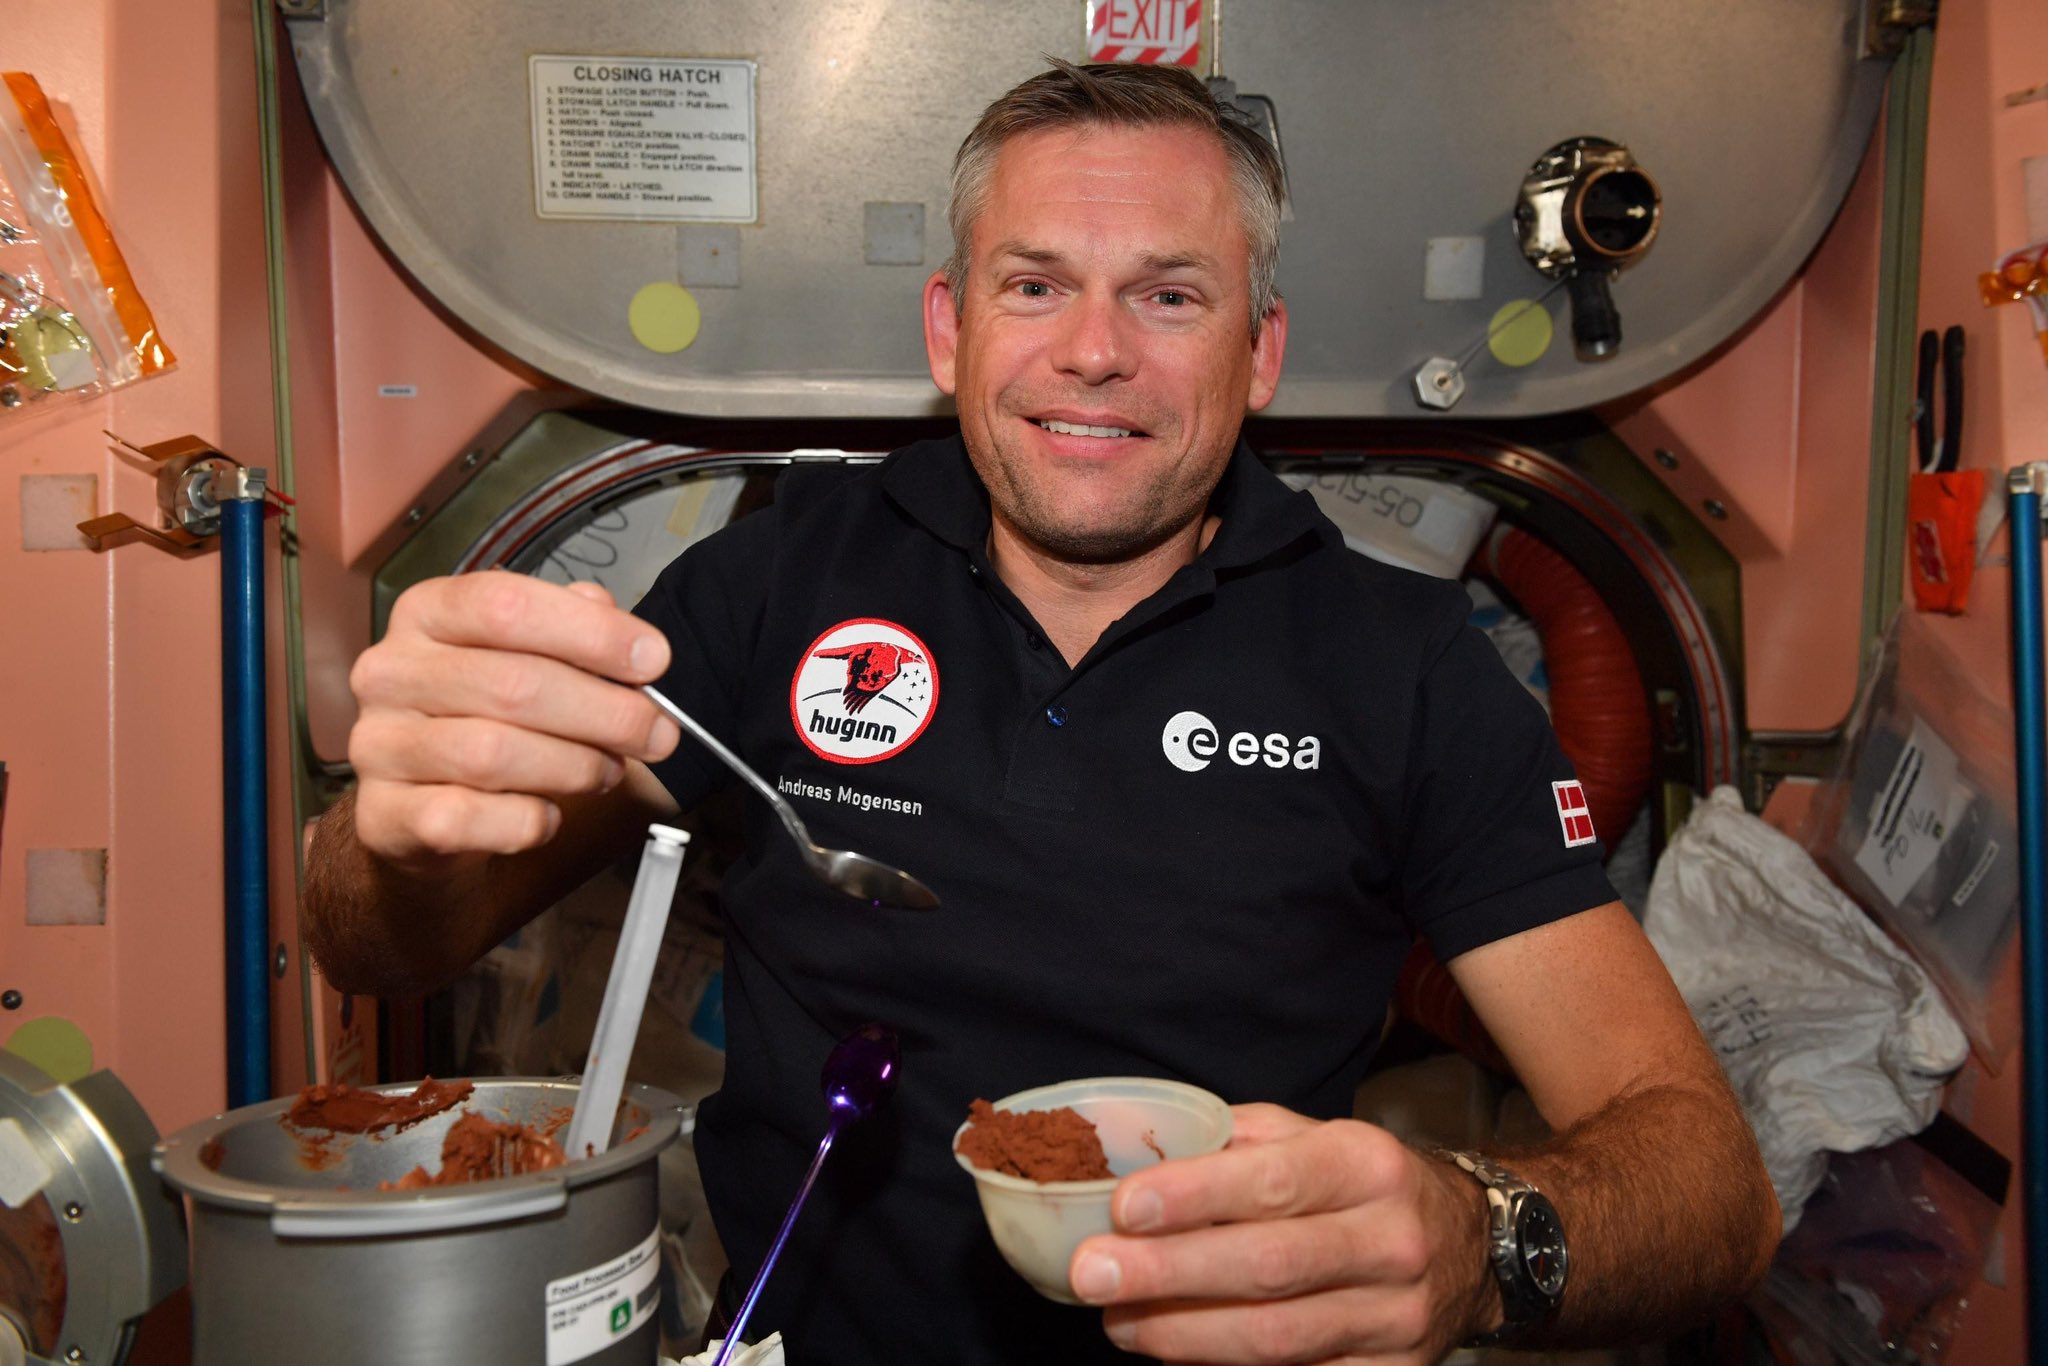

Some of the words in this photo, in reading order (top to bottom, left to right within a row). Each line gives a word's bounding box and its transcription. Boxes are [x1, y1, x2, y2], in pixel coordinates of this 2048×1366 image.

[1109, 0, 1185, 41] EXIT
[574, 66, 652, 82] CLOSING
[659, 68, 721, 83] HATCH
[558, 86, 602, 95] STOWAGE
[640, 88, 676, 96] BUTTON
[558, 97, 603, 105] STOWAGE
[607, 98, 638, 106] LATCH
[640, 100, 675, 108] HANDLE
[558, 108, 590, 116] HATCH
[600, 108, 621, 116] Push
[559, 119, 599, 127] ARROWS
[560, 129, 605, 137] PRESSURE
[607, 130, 673, 139] EQUALIZATION
[560, 140, 601, 148] RATCHET
[612, 141, 642, 149] LATCH
[560, 150, 591, 158] CRANK
[594, 151, 629, 159] HANDLE
[640, 152, 678, 161] Engaged
[560, 160, 592, 168] CRANK
[594, 161, 630, 169] HANDLE
[641, 162, 660, 170] Turn
[672, 163, 703, 171] LATCH
[706, 164, 743, 172] direction
[562, 181, 610, 189] INDICATOR
[562, 191, 593, 199] CRANK
[596, 192, 631, 200] HANDLE
[642, 193, 674, 201] Stowed
[809, 709, 897, 744] huginn
[1228, 731, 1321, 770] esa
[778, 775, 832, 801] Andreas
[837, 785, 923, 816] Mogensen
[552, 1282, 580, 1296] Food
